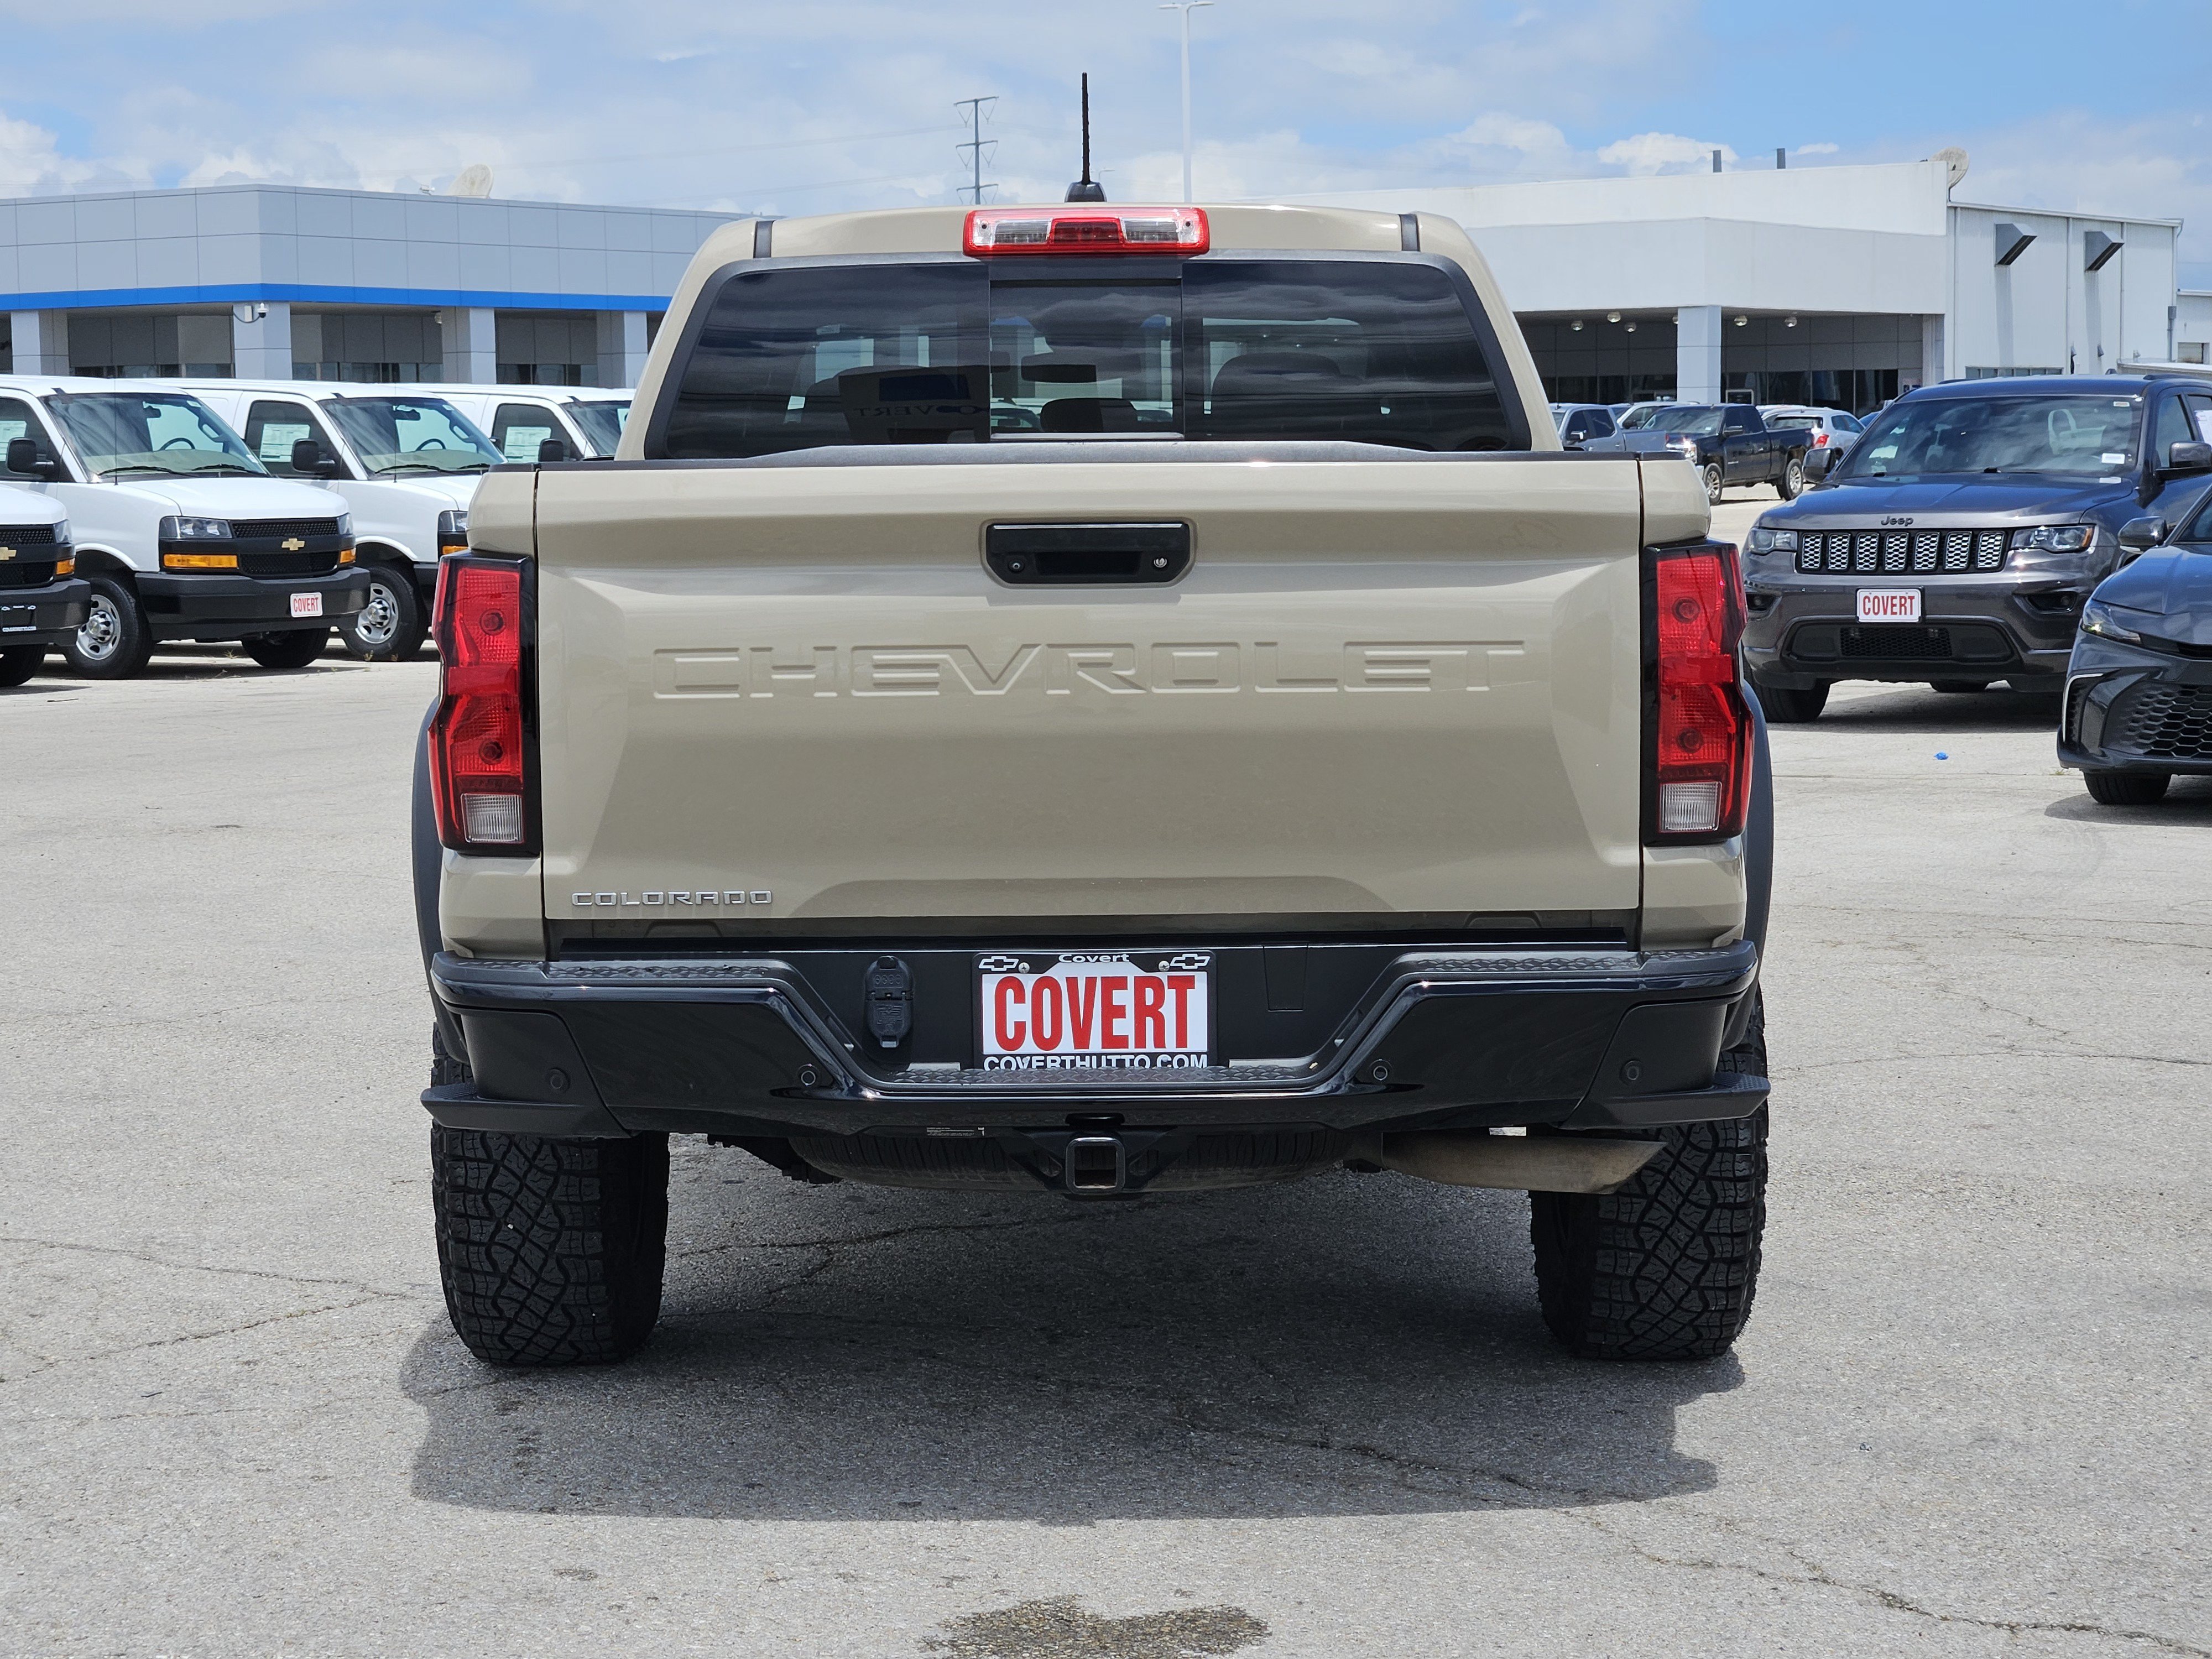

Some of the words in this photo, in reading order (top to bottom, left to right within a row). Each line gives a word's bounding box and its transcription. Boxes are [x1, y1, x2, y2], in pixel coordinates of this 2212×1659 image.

[1881, 516, 1914, 527] Jeep
[293, 597, 319, 613] COVERT
[1863, 595, 1915, 615] COVERT
[653, 640, 1525, 699] CHEVROLET
[572, 891, 772, 906] COLORADO
[1058, 954, 1130, 963] Covert
[995, 975, 1196, 1051] COVERT
[983, 1053, 1208, 1071] COVERTHUTTOCOM
